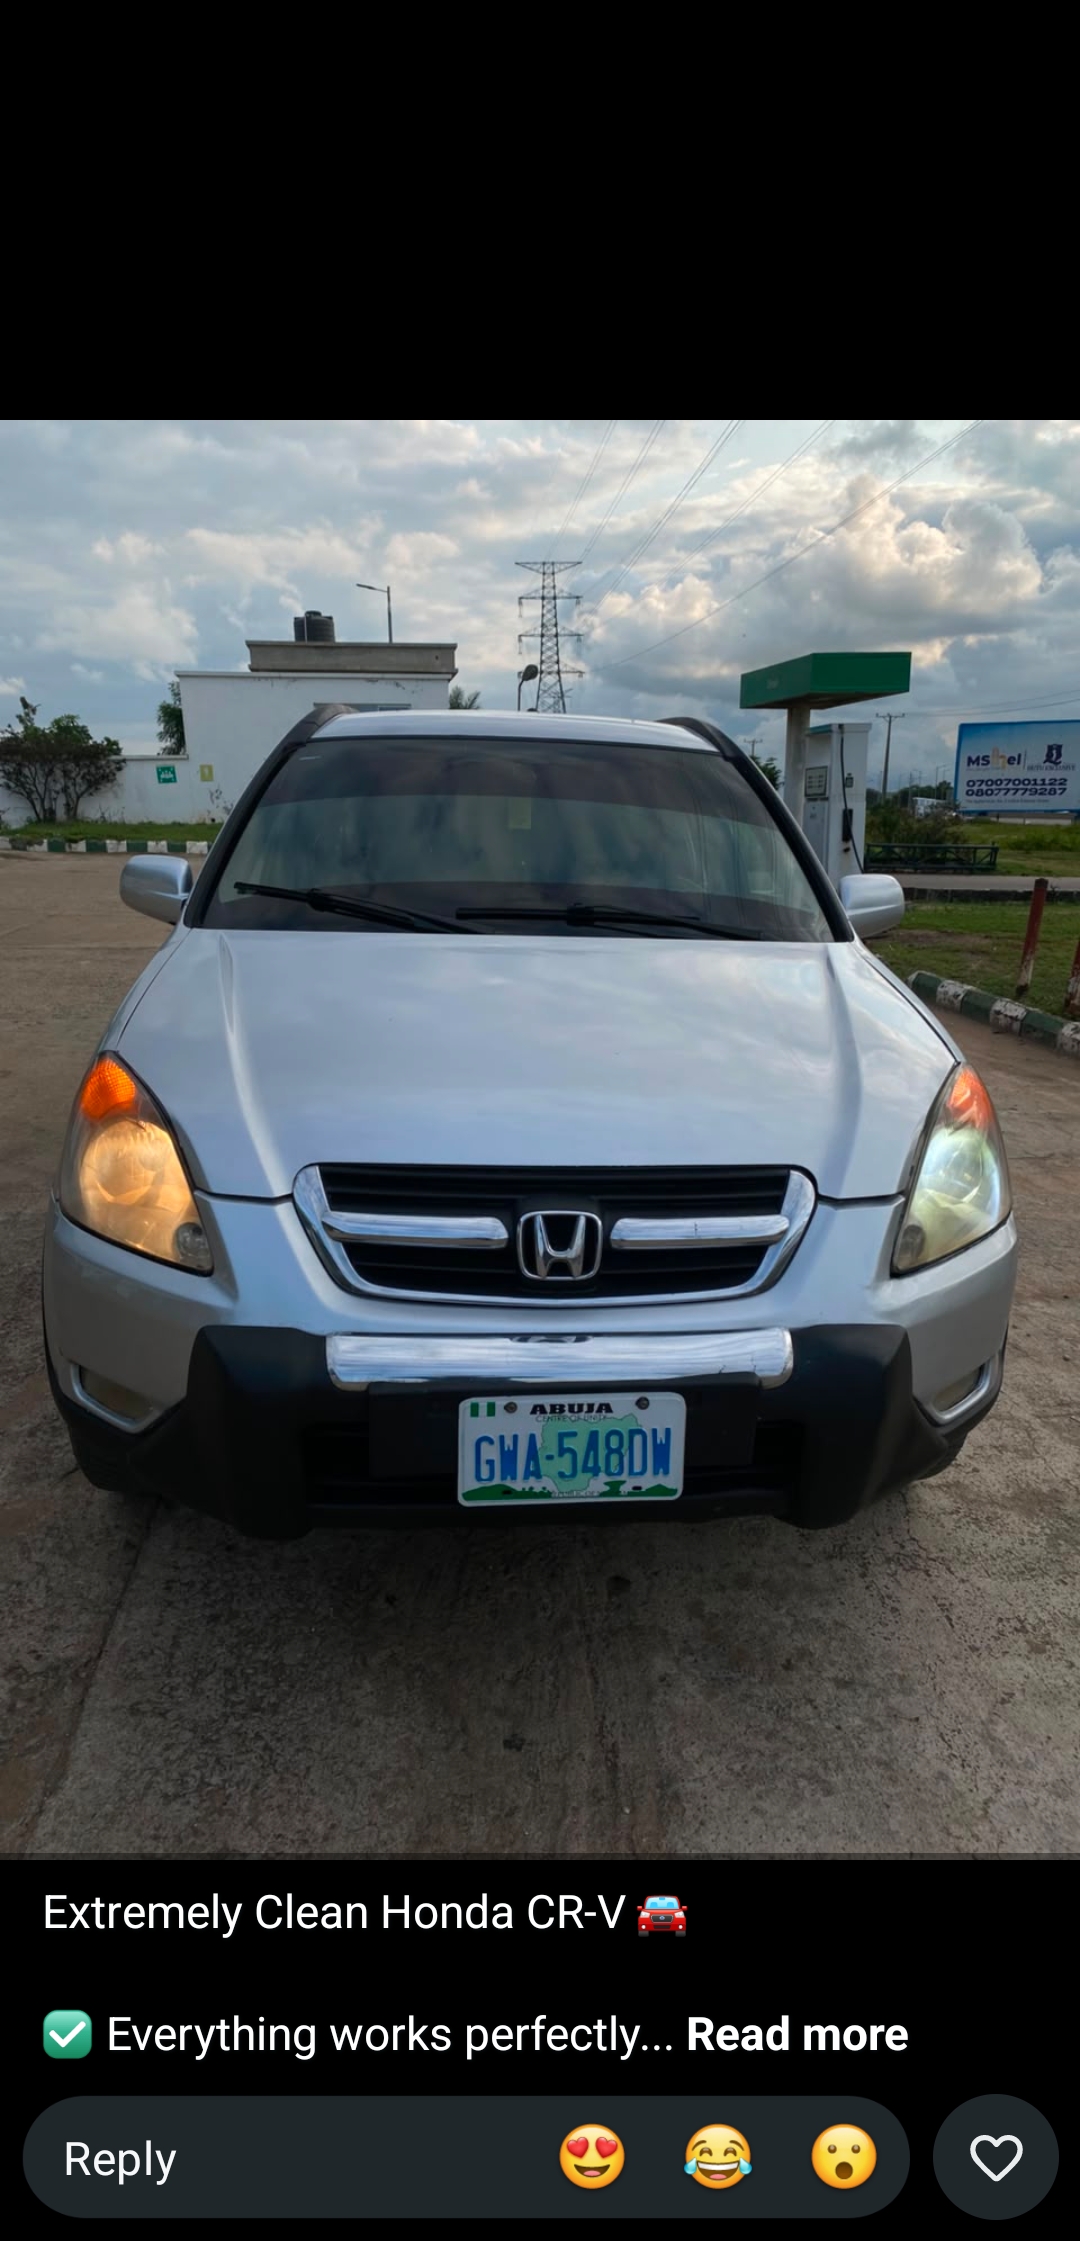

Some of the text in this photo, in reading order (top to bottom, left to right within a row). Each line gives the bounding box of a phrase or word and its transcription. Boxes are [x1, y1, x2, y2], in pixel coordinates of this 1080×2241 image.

[966, 778, 1068, 788] 07007001122
[965, 787, 1067, 797] 08077779287
[530, 1402, 614, 1415] ABUJA
[474, 1427, 672, 1483] GWA-548DW
